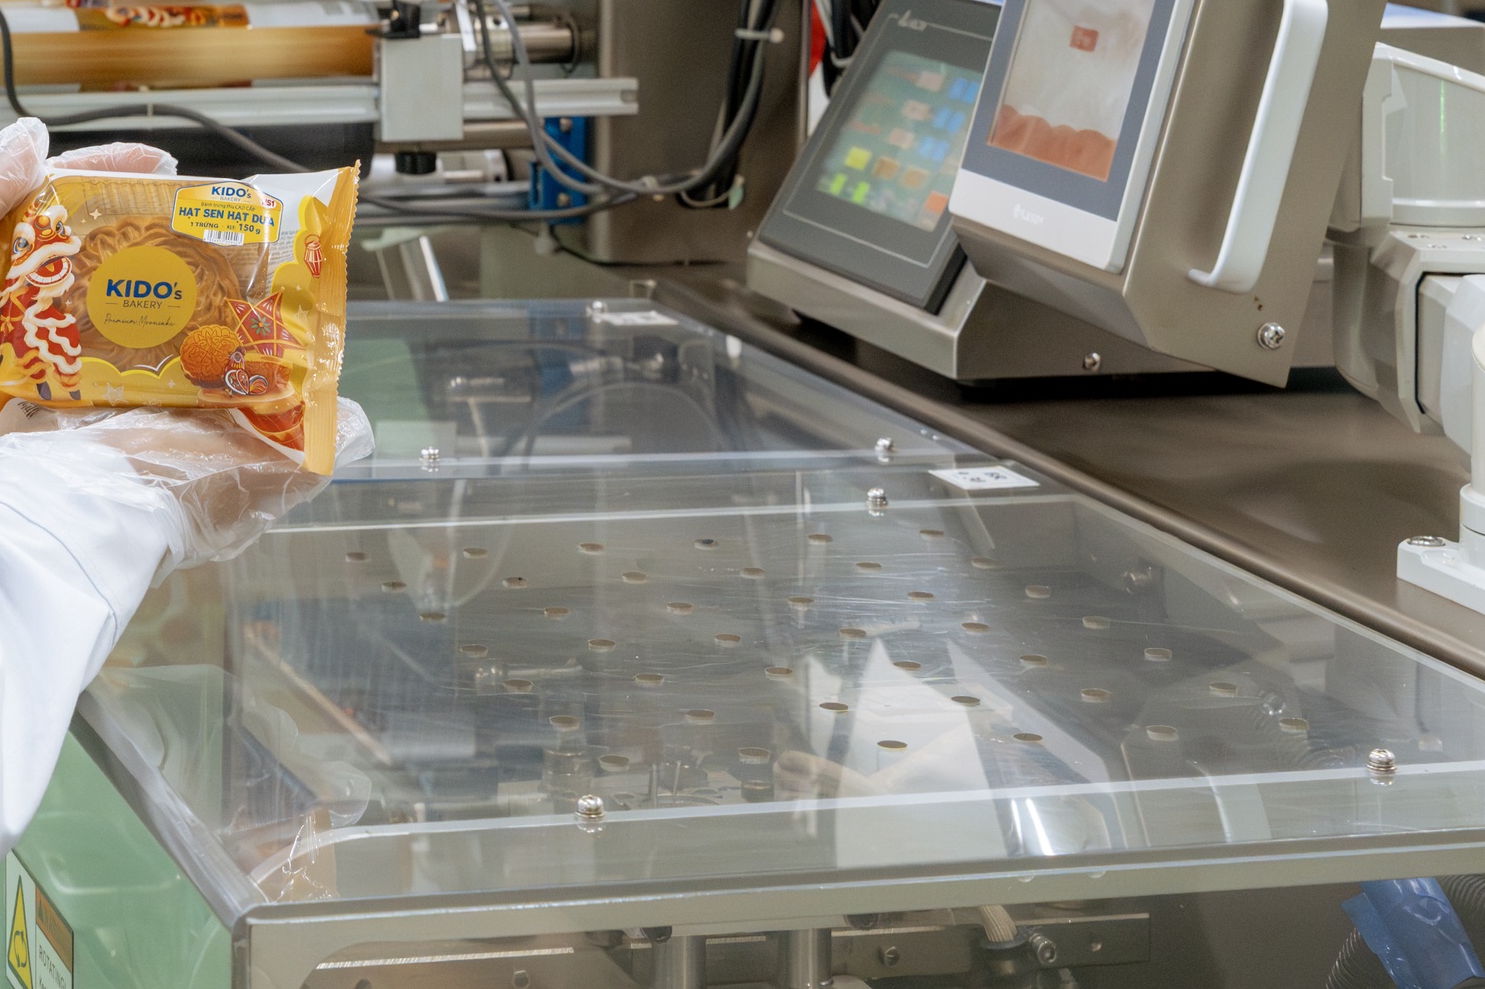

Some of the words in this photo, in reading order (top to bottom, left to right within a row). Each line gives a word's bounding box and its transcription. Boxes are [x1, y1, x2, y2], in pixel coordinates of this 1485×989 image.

[211, 185, 252, 199] KIDO's
[178, 207, 201, 220] HẠT
[203, 208, 225, 219] SEN
[227, 211, 250, 224] HẠT
[238, 223, 255, 233] 150
[106, 278, 183, 300] KIDO's
[123, 300, 163, 309] BAKERY
[104, 312, 137, 325] Premium
